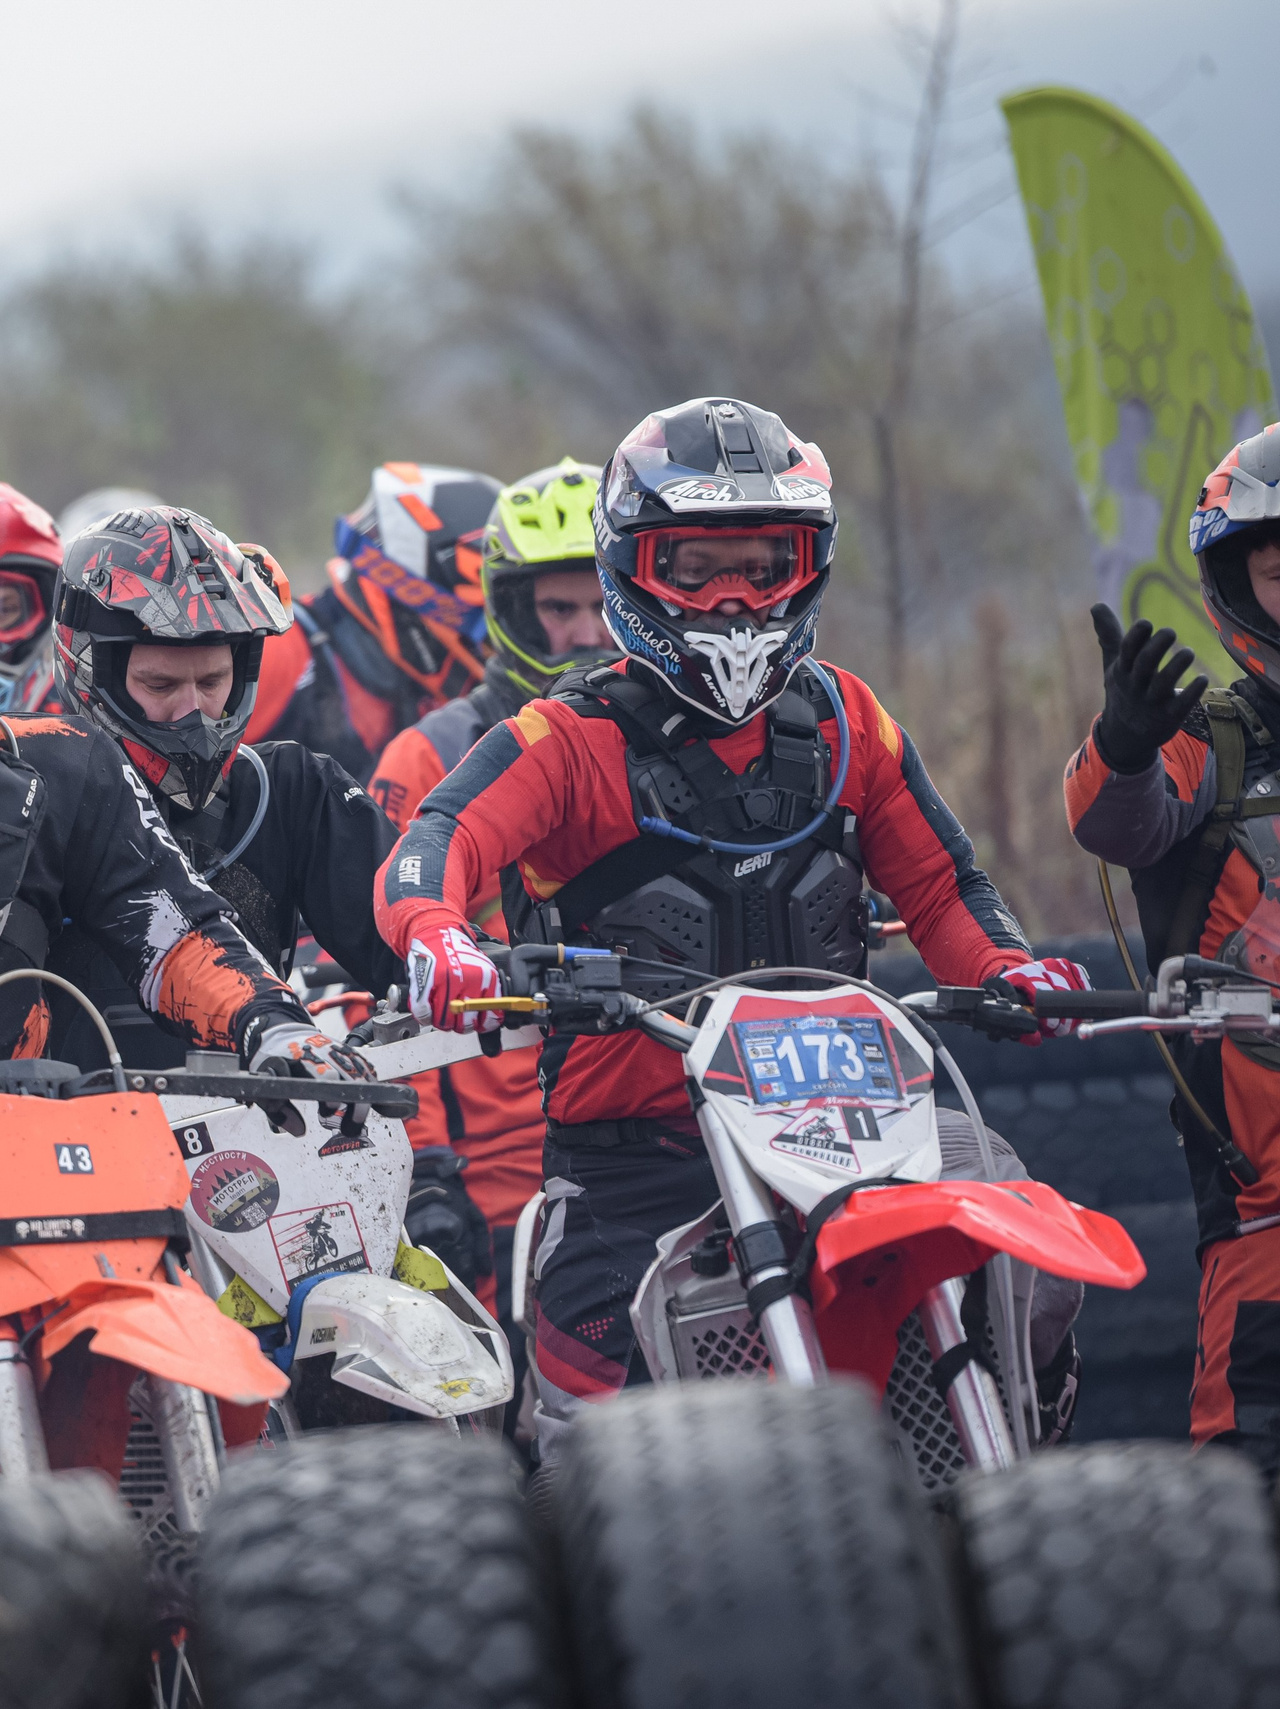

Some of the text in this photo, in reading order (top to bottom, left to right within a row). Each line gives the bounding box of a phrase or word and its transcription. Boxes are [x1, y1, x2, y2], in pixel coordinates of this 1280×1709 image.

[667, 479, 733, 501] Airoh
[782, 478, 826, 500] Airoh
[733, 850, 775, 878] LEATT
[776, 1033, 866, 1084] 173
[854, 1109, 871, 1139] 1
[183, 1127, 203, 1155] 8
[58, 1145, 93, 1172] 43
[198, 1151, 248, 1175] МЕСТНОСТИ
[212, 1173, 255, 1207] МОТОТРЕП
